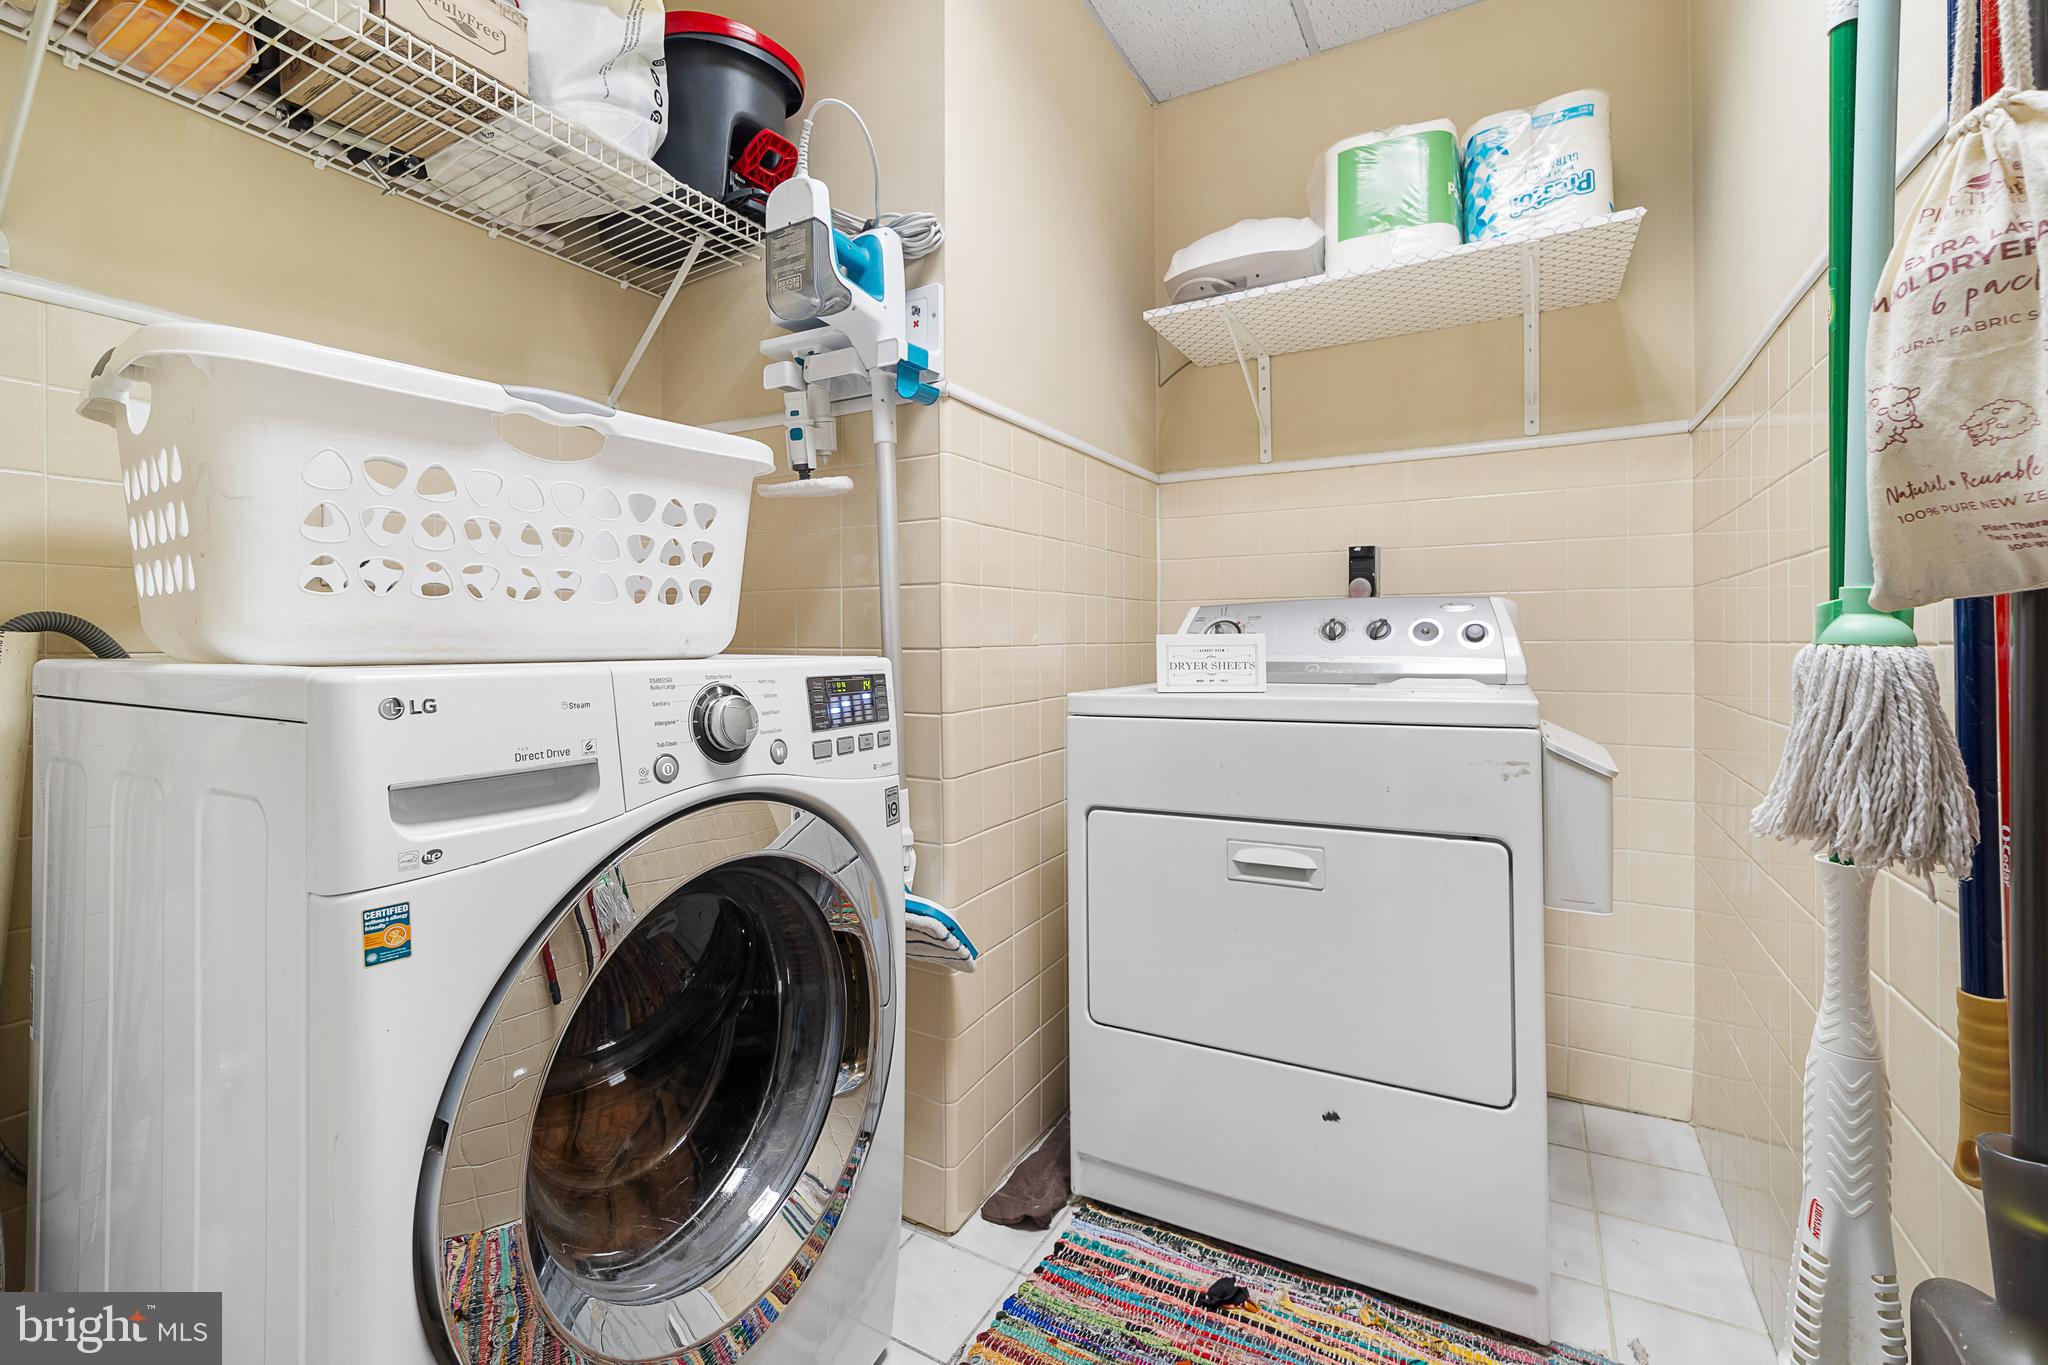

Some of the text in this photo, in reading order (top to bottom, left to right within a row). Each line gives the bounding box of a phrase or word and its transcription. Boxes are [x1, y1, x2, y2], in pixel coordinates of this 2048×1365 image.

[1872, 275, 1921, 313] WOL
[1931, 286, 1947, 316] 6
[1949, 312, 2022, 338] FABRIC
[1885, 453, 2044, 507] Natural Reusable
[1897, 506, 1941, 525] 100%
[1942, 500, 1979, 514] PURE
[1981, 495, 2017, 510] NEW
[1169, 660, 1256, 671] DRYER SHEETS
[409, 698, 438, 716] LG
[568, 701, 592, 710] Steam
[514, 750, 544, 763] Direct
[546, 747, 571, 759] Drive
[363, 904, 409, 921] CERTIFIED
[1812, 1200, 1824, 1240] LIBMAN
